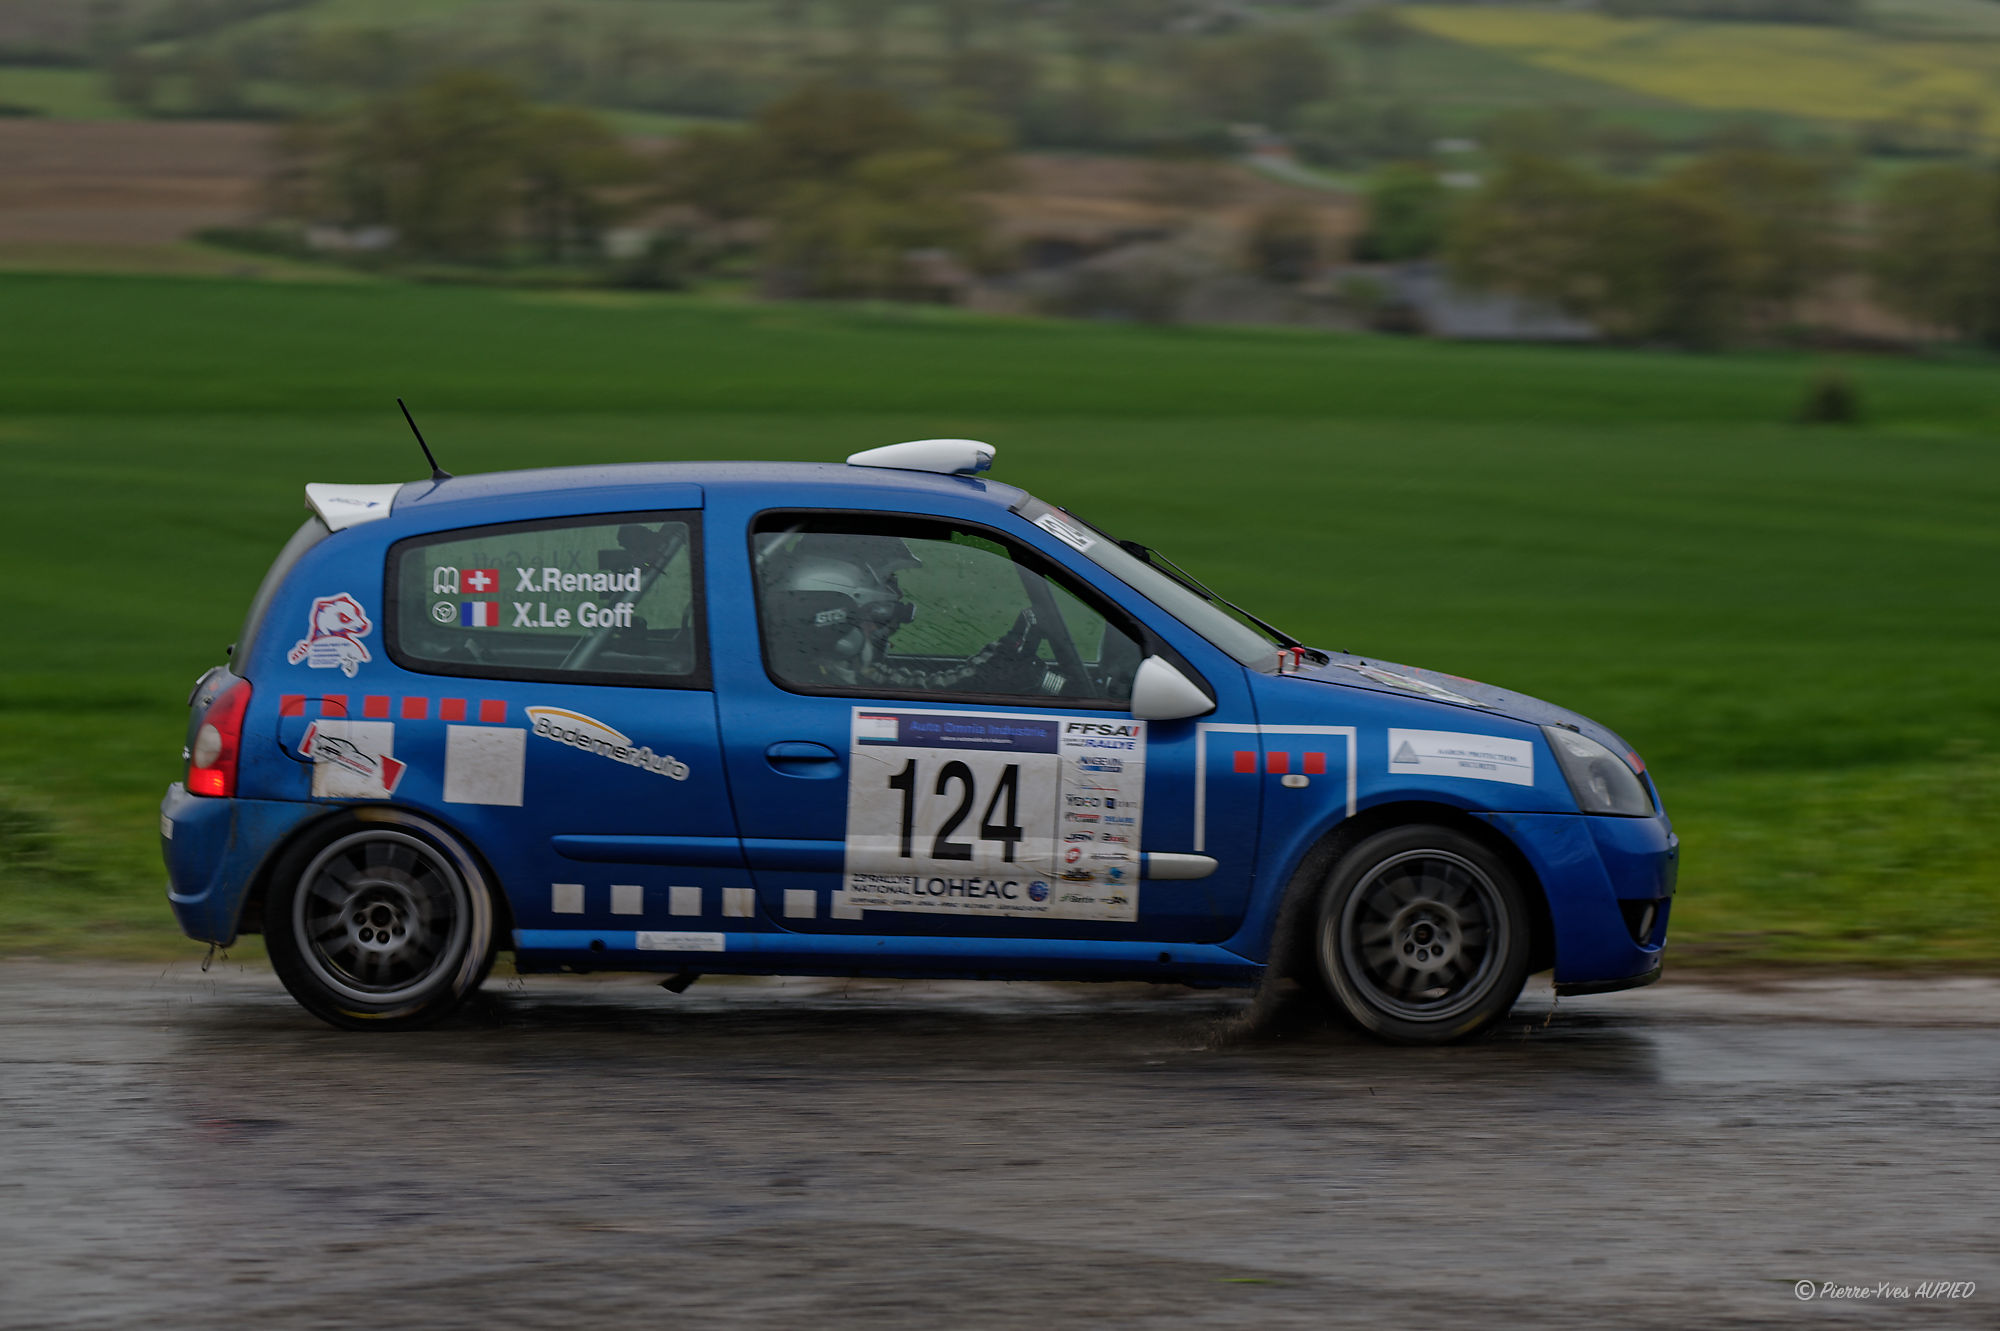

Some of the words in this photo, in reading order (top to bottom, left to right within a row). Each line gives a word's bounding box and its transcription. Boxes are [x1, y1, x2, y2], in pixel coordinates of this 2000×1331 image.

[515, 567, 641, 593] X.Renaud
[512, 601, 571, 628] X.Le
[577, 601, 635, 628] Goff
[909, 720, 942, 732] Auto
[943, 722, 985, 735] Omnia
[988, 724, 1048, 738] Industrie
[1066, 722, 1129, 737] FFSA
[1085, 739, 1136, 750] RALLYE
[890, 758, 1022, 862] 124
[851, 884, 910, 895] NATIONAL
[913, 876, 1019, 900] LOHÉAC
